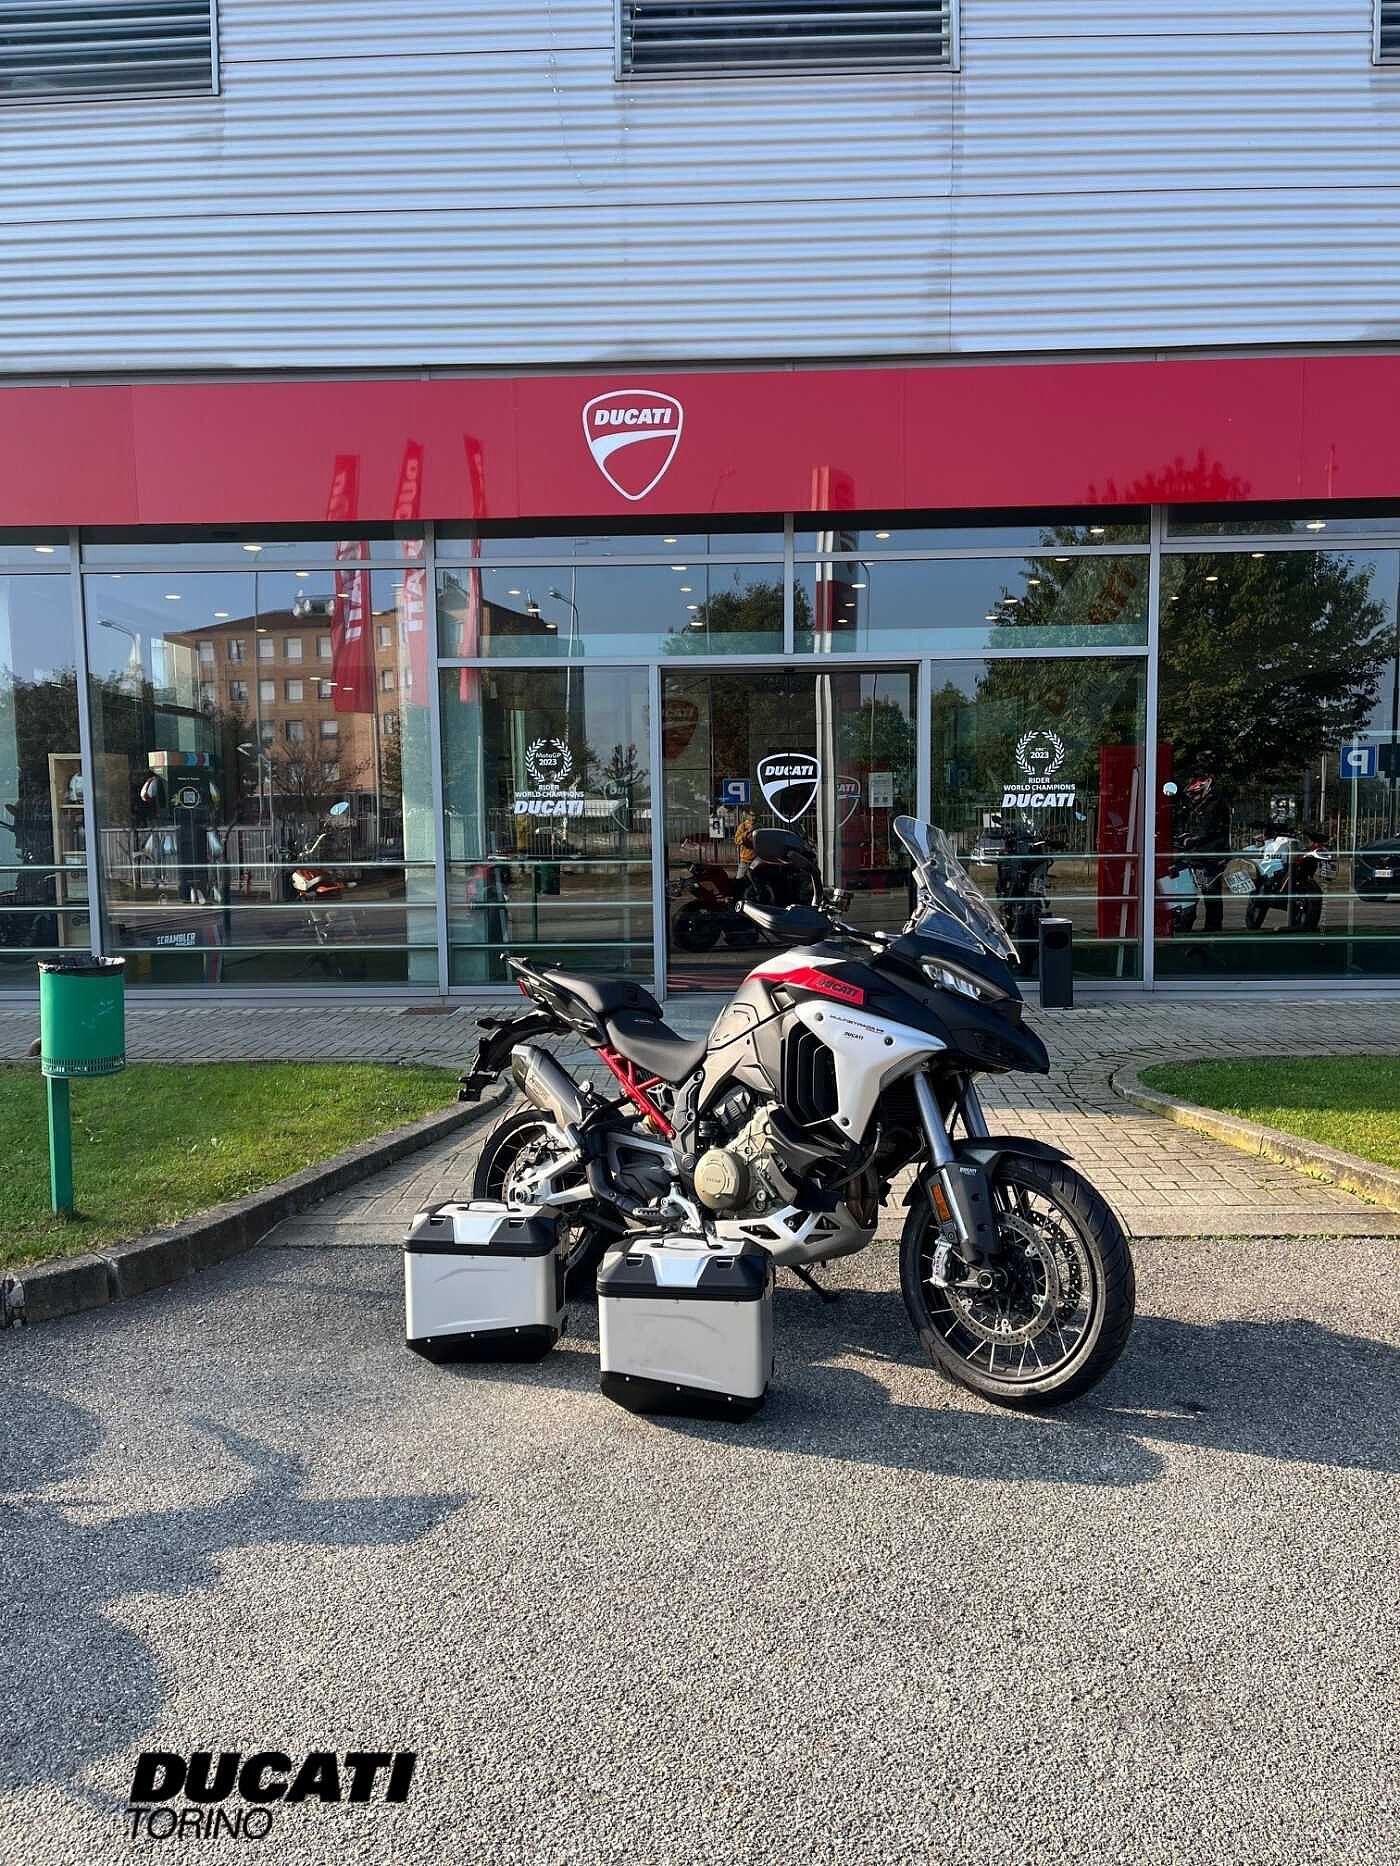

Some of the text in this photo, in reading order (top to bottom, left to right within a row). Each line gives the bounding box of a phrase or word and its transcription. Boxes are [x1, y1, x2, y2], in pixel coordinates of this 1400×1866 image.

[595, 408, 672, 425] DUCATI
[765, 765, 814, 776] DUCATI
[1001, 793, 1075, 807] DUCATI
[513, 800, 584, 816] DUCATI
[156, 932, 196, 945] SCRAMBLER
